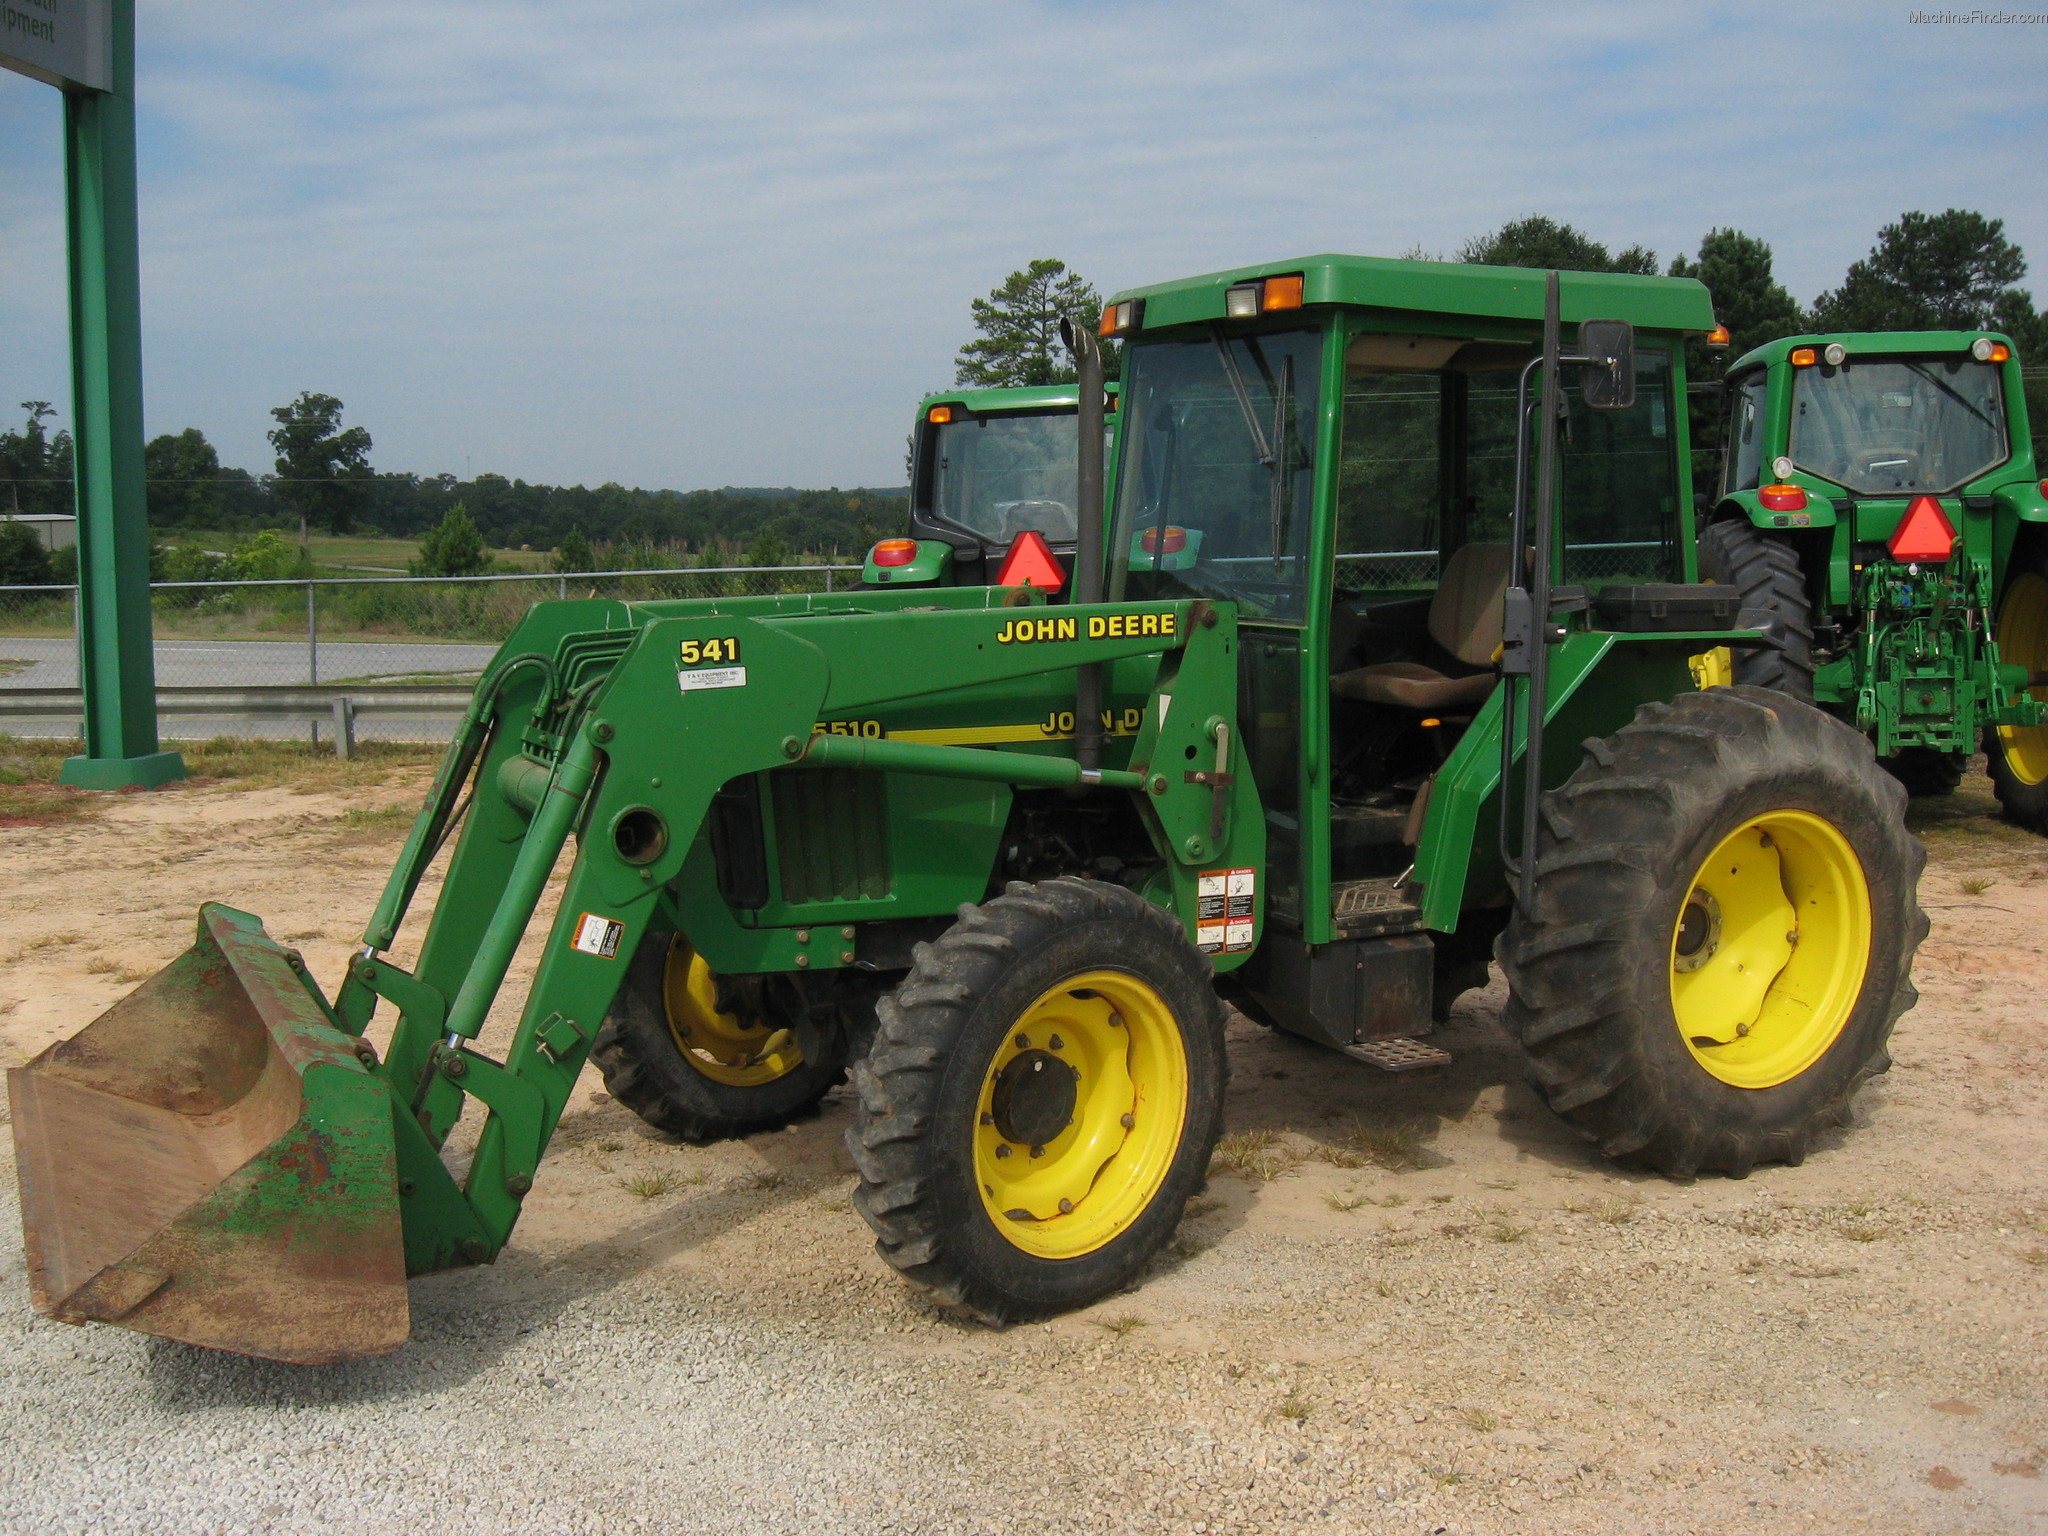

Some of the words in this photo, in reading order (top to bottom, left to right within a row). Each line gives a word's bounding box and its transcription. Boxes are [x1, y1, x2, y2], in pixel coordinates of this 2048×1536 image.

[0, 2, 55, 43] ipment
[997, 617, 1078, 644] JOHN
[1088, 612, 1176, 639] DEERE
[680, 637, 740, 664] 541
[1041, 709, 1113, 734] JON
